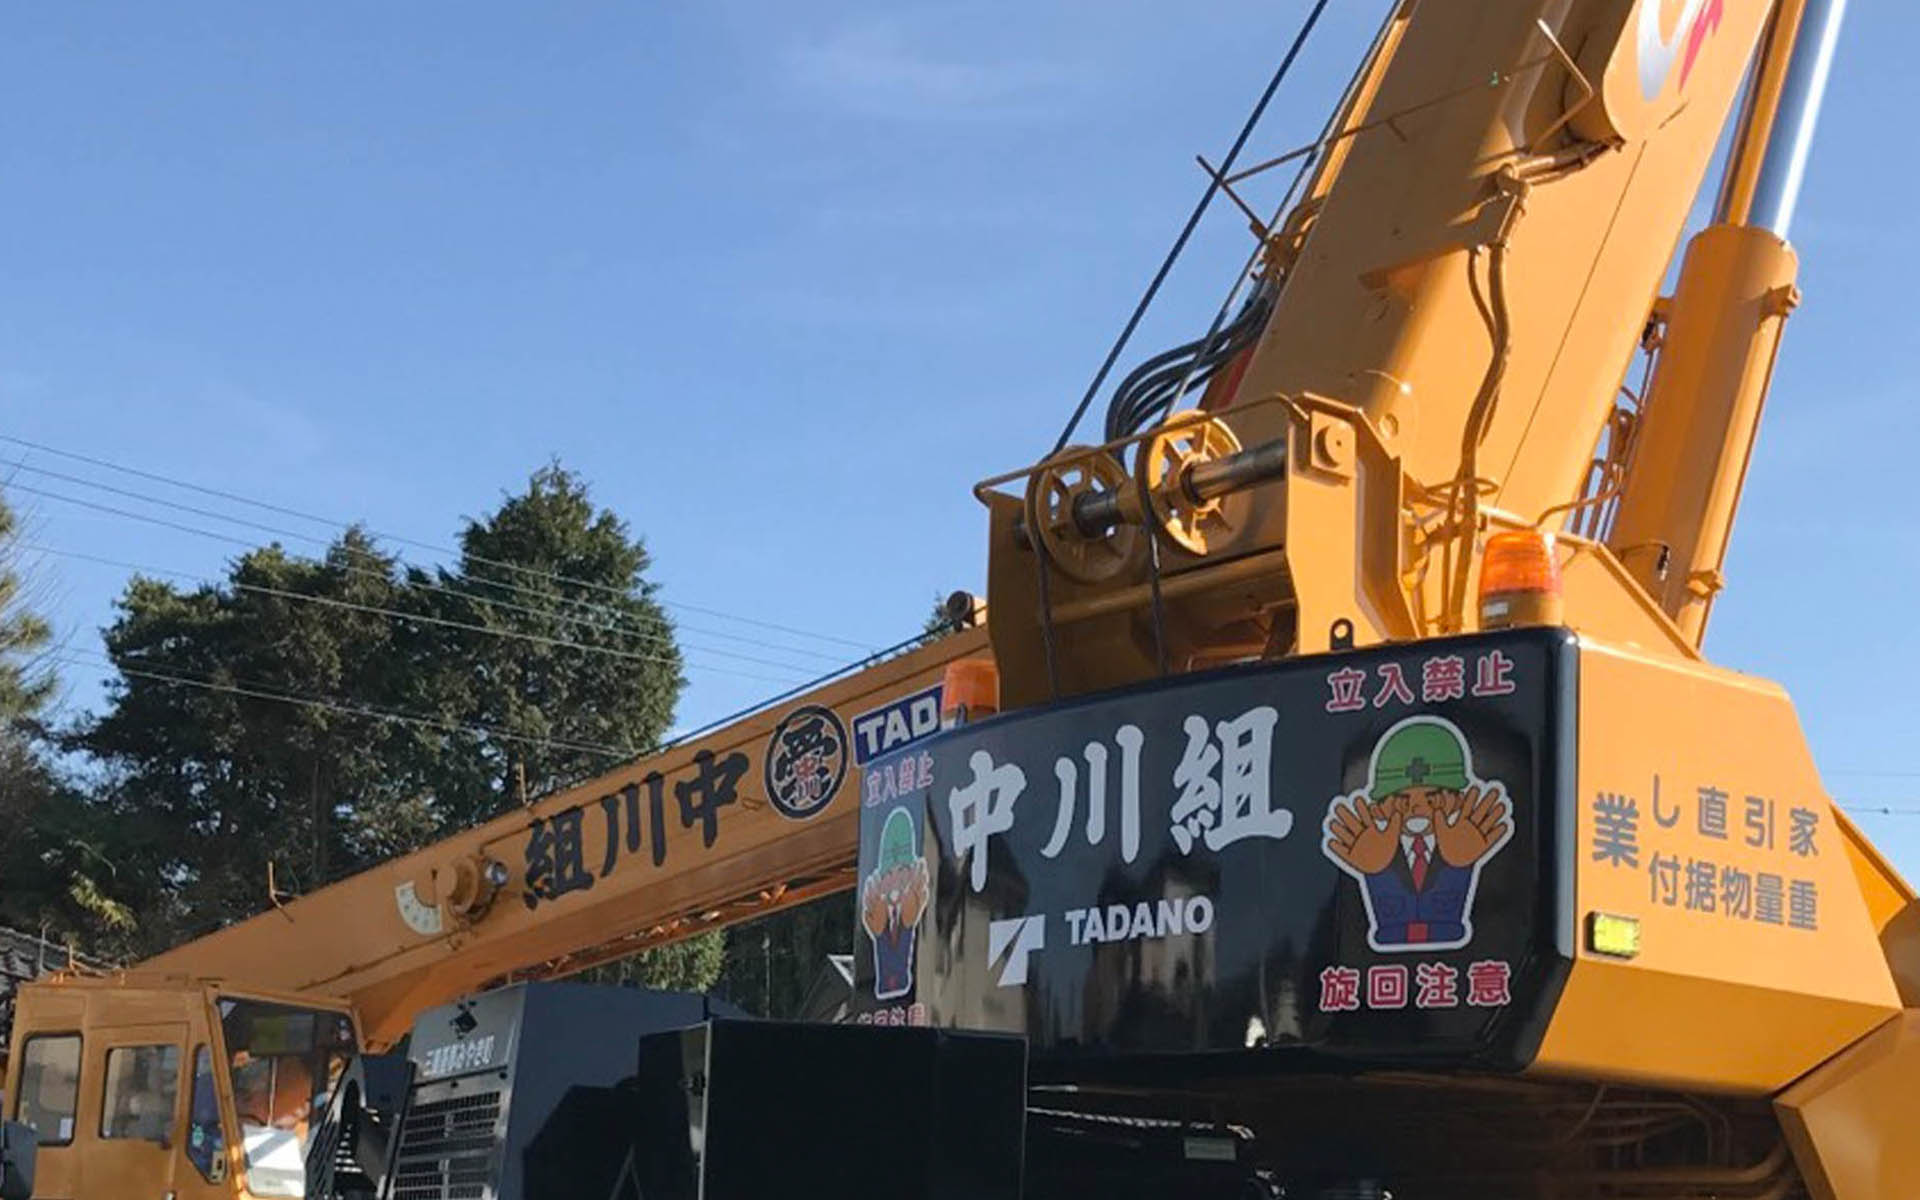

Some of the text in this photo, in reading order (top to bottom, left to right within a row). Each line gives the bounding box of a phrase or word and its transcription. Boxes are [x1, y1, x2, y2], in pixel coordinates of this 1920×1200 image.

[1326, 650, 1515, 711] 立入禁止
[949, 706, 1294, 893] 中川組
[1065, 896, 1214, 946] TADANO
[1320, 960, 1512, 1012] 旋回注意
